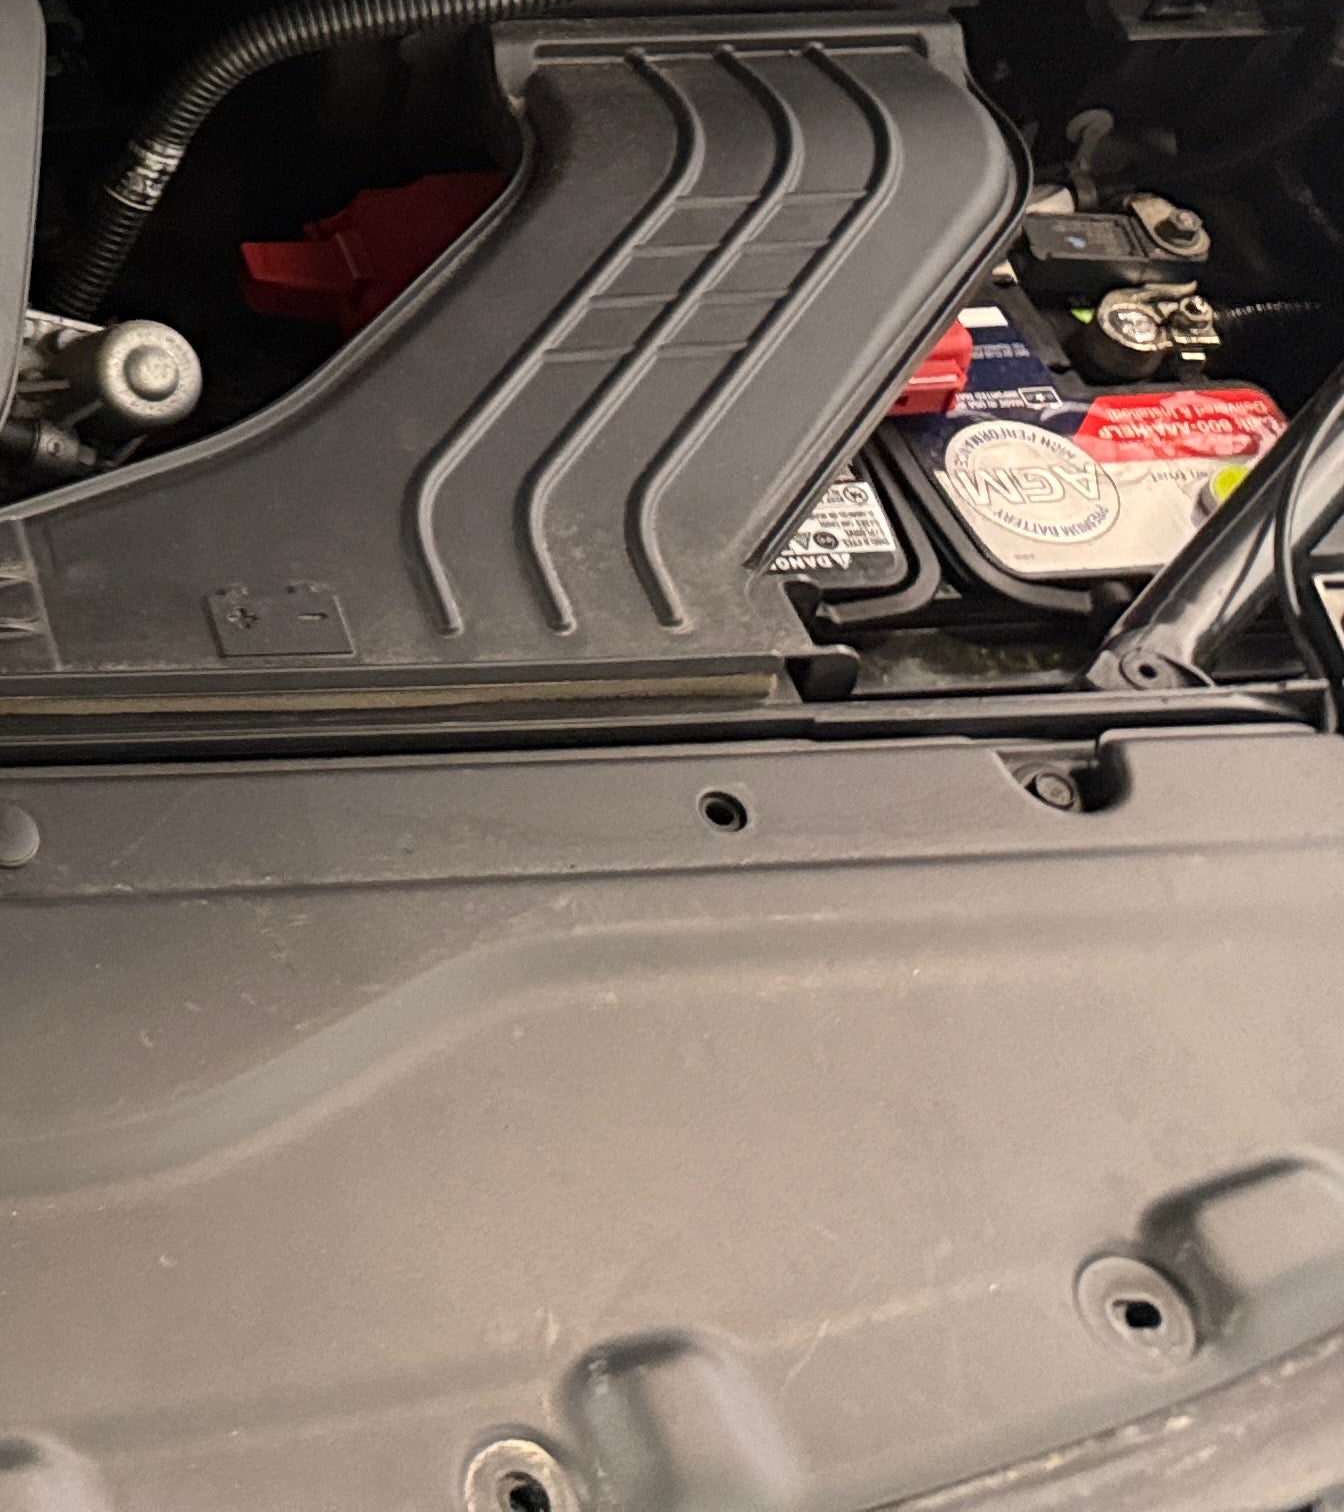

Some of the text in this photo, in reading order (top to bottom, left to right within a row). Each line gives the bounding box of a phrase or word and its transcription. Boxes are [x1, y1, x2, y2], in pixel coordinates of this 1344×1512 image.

[954, 463, 1101, 507] AGM
[994, 504, 1110, 538] PREMIUM BATTERY
